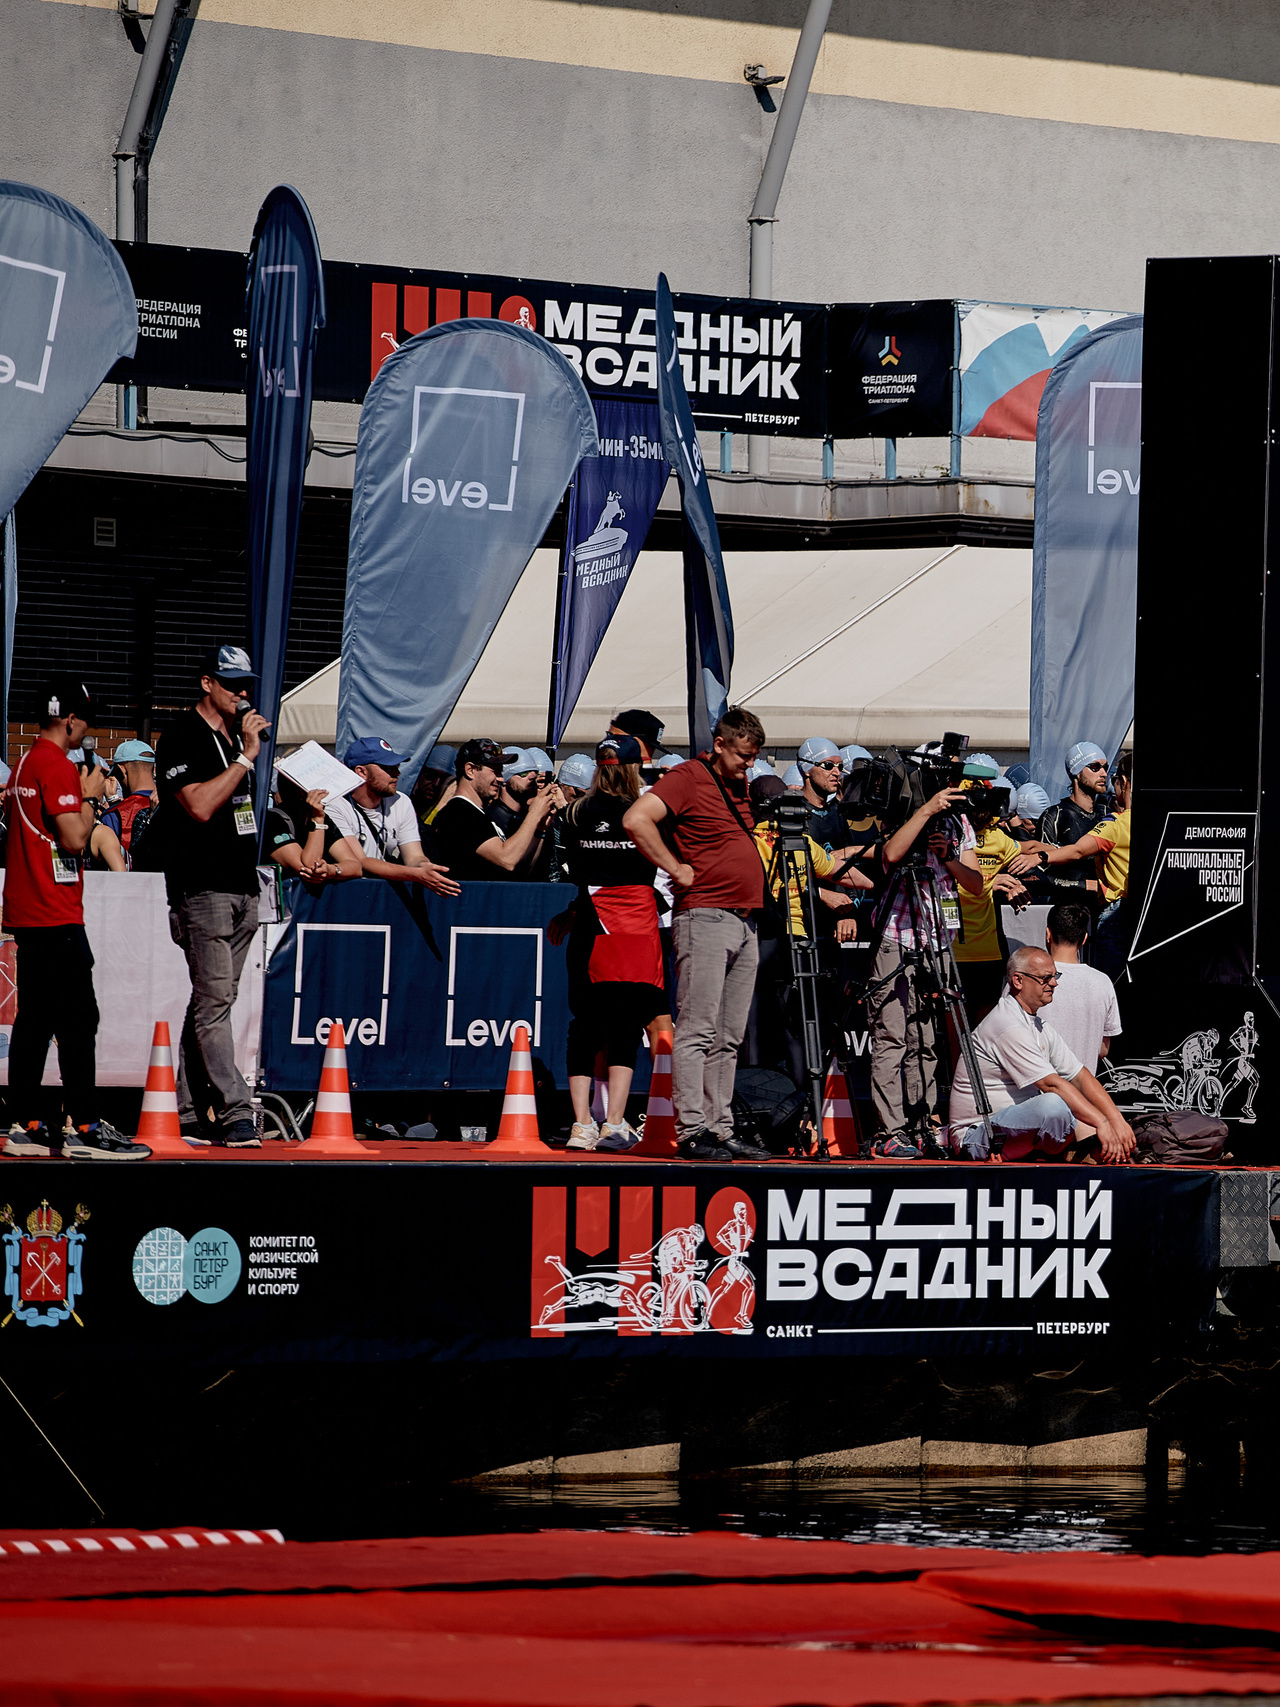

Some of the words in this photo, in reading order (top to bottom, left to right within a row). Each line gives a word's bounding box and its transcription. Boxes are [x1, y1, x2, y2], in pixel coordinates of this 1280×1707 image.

[861, 374, 918, 385] ФЕДЕРАЦИЯ
[863, 384, 916, 395] ТРИАТЛОНА
[744, 413, 801, 426] ПЕТЕРБУРГ
[575, 552, 621, 578] МЕДНЫЙ
[1184, 827, 1247, 840] ДЕМОГРАФИЯ
[1167, 852, 1242, 870] НАЦИОНАЛЬНЫЕ
[1198, 869, 1241, 886] ПРОЕКТЫ
[1205, 886, 1241, 903] РОССИИ
[290, 997, 389, 1046] Level
[766, 1179, 1113, 1242] МЕДНЫЙ
[193, 1241, 229, 1257] САНКТ
[249, 1236, 298, 1248] КОМИТЕТ
[298, 1236, 316, 1248] ПО
[248, 1249, 319, 1264] ФИЗИЧЕСКОЙ
[193, 1258, 229, 1274] ПЕТЕР
[248, 1267, 297, 1280] КУЛЬТУРЕ
[766, 1247, 1111, 1301] ВСАДНИК
[193, 1274, 222, 1290] БУРГ
[247, 1283, 256, 1295] И
[257, 1283, 300, 1296] СПОРТУ
[766, 1325, 814, 1338] САНКТ
[1036, 1321, 1111, 1335] ПЕТЕРБУРГ
